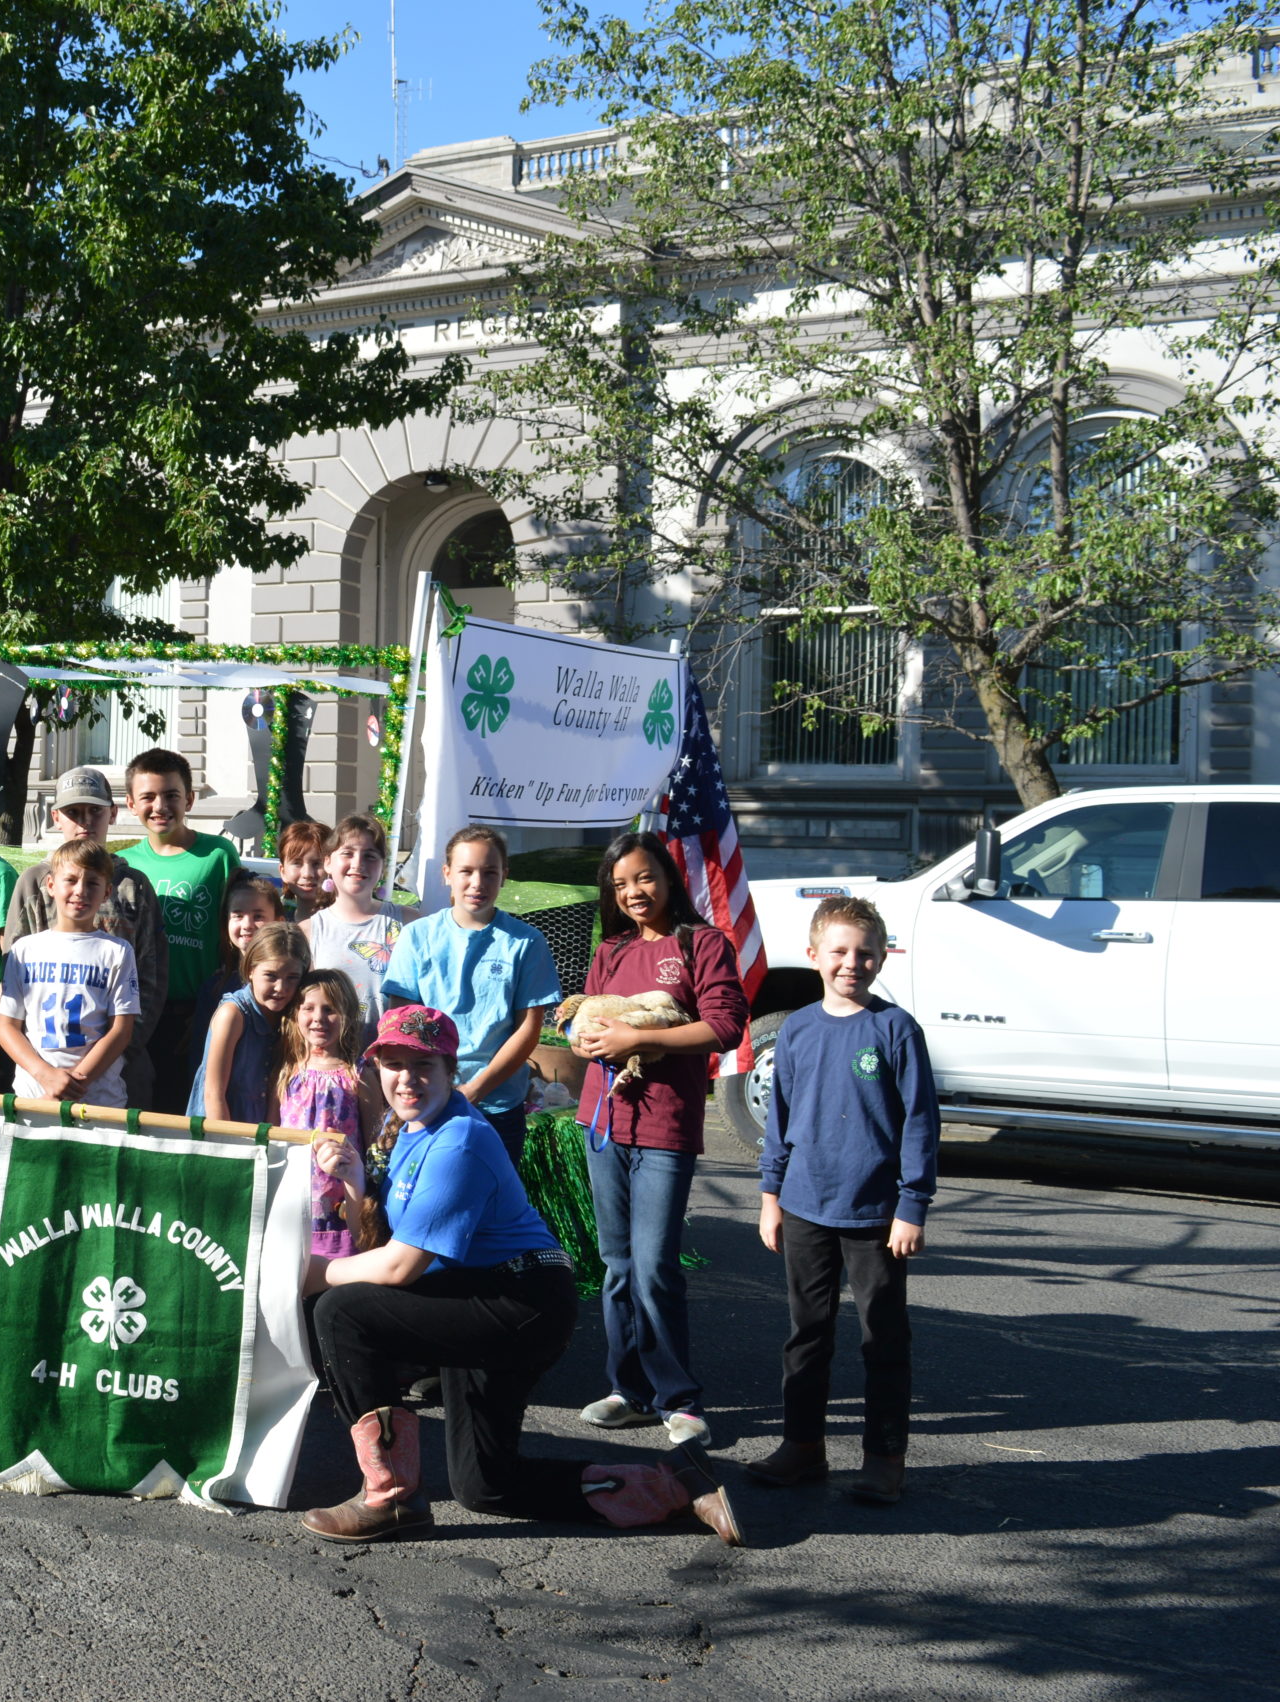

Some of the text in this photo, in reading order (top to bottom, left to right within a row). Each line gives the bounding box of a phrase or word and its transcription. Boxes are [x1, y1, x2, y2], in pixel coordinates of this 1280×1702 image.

[434, 300, 598, 343] RECORS
[556, 666, 640, 703] Walla Walla
[553, 699, 631, 738] County 4H
[535, 782, 555, 806] Up
[556, 783, 582, 802] Fun
[579, 784, 598, 808] for
[598, 784, 650, 806] Everyone
[165, 934, 204, 950] OWKIDS
[24, 962, 110, 989] BLUE DEVILS
[41, 992, 86, 1049] 11
[941, 1012, 1006, 1024] RAM
[81, 1203, 163, 1237] WALLA
[167, 1220, 245, 1292] COUNTY
[31, 1359, 179, 1402] 4-H CLUBS
